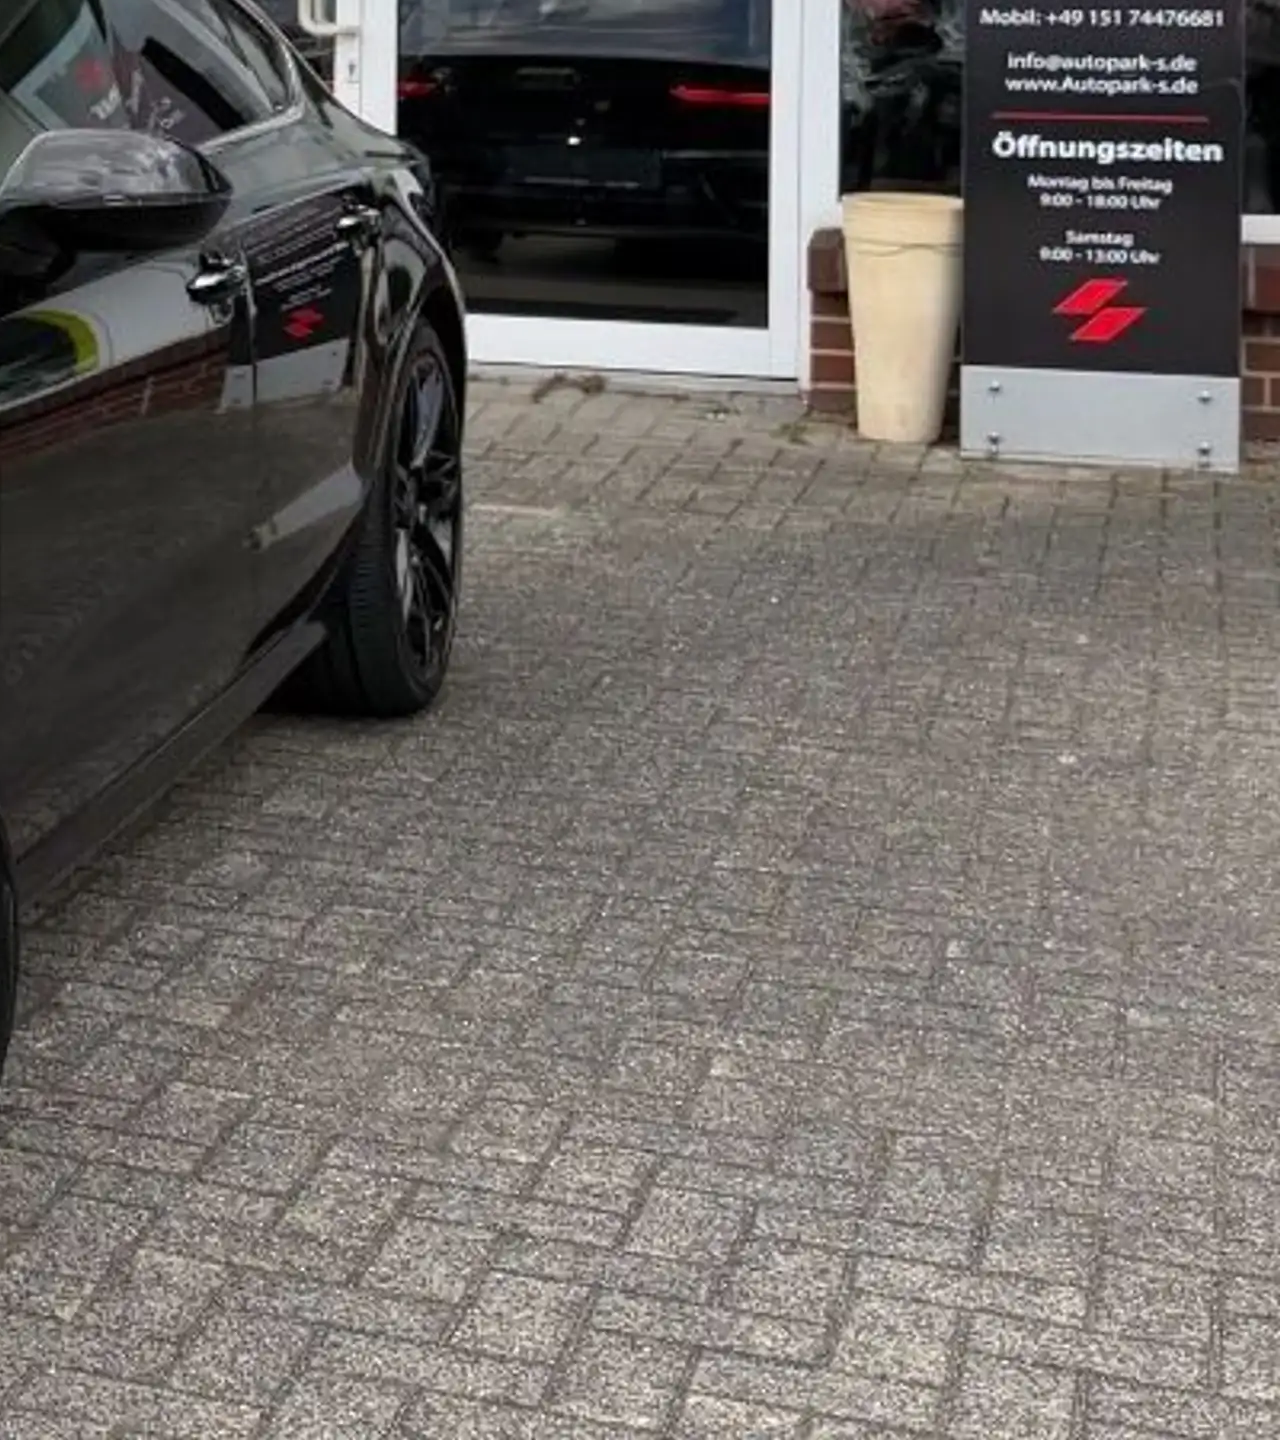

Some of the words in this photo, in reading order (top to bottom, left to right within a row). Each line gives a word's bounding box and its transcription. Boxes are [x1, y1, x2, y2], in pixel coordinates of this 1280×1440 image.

[979, 9, 1041, 26] Mobil:
[1045, 10, 1083, 26] +49
[1090, 10, 1122, 26] 151
[1007, 52, 1197, 74] info@autopark-s.de
[992, 130, 1224, 164] Öffnungszeiten
[1027, 174, 1089, 193] Montag
[1091, 175, 1115, 191] bis
[1117, 176, 1173, 195] Freitag
[1040, 193, 1073, 207] 9:00
[1130, 195, 1161, 210] Uhr
[1064, 230, 1135, 248] Samstag
[1130, 250, 1161, 264] Uhr
